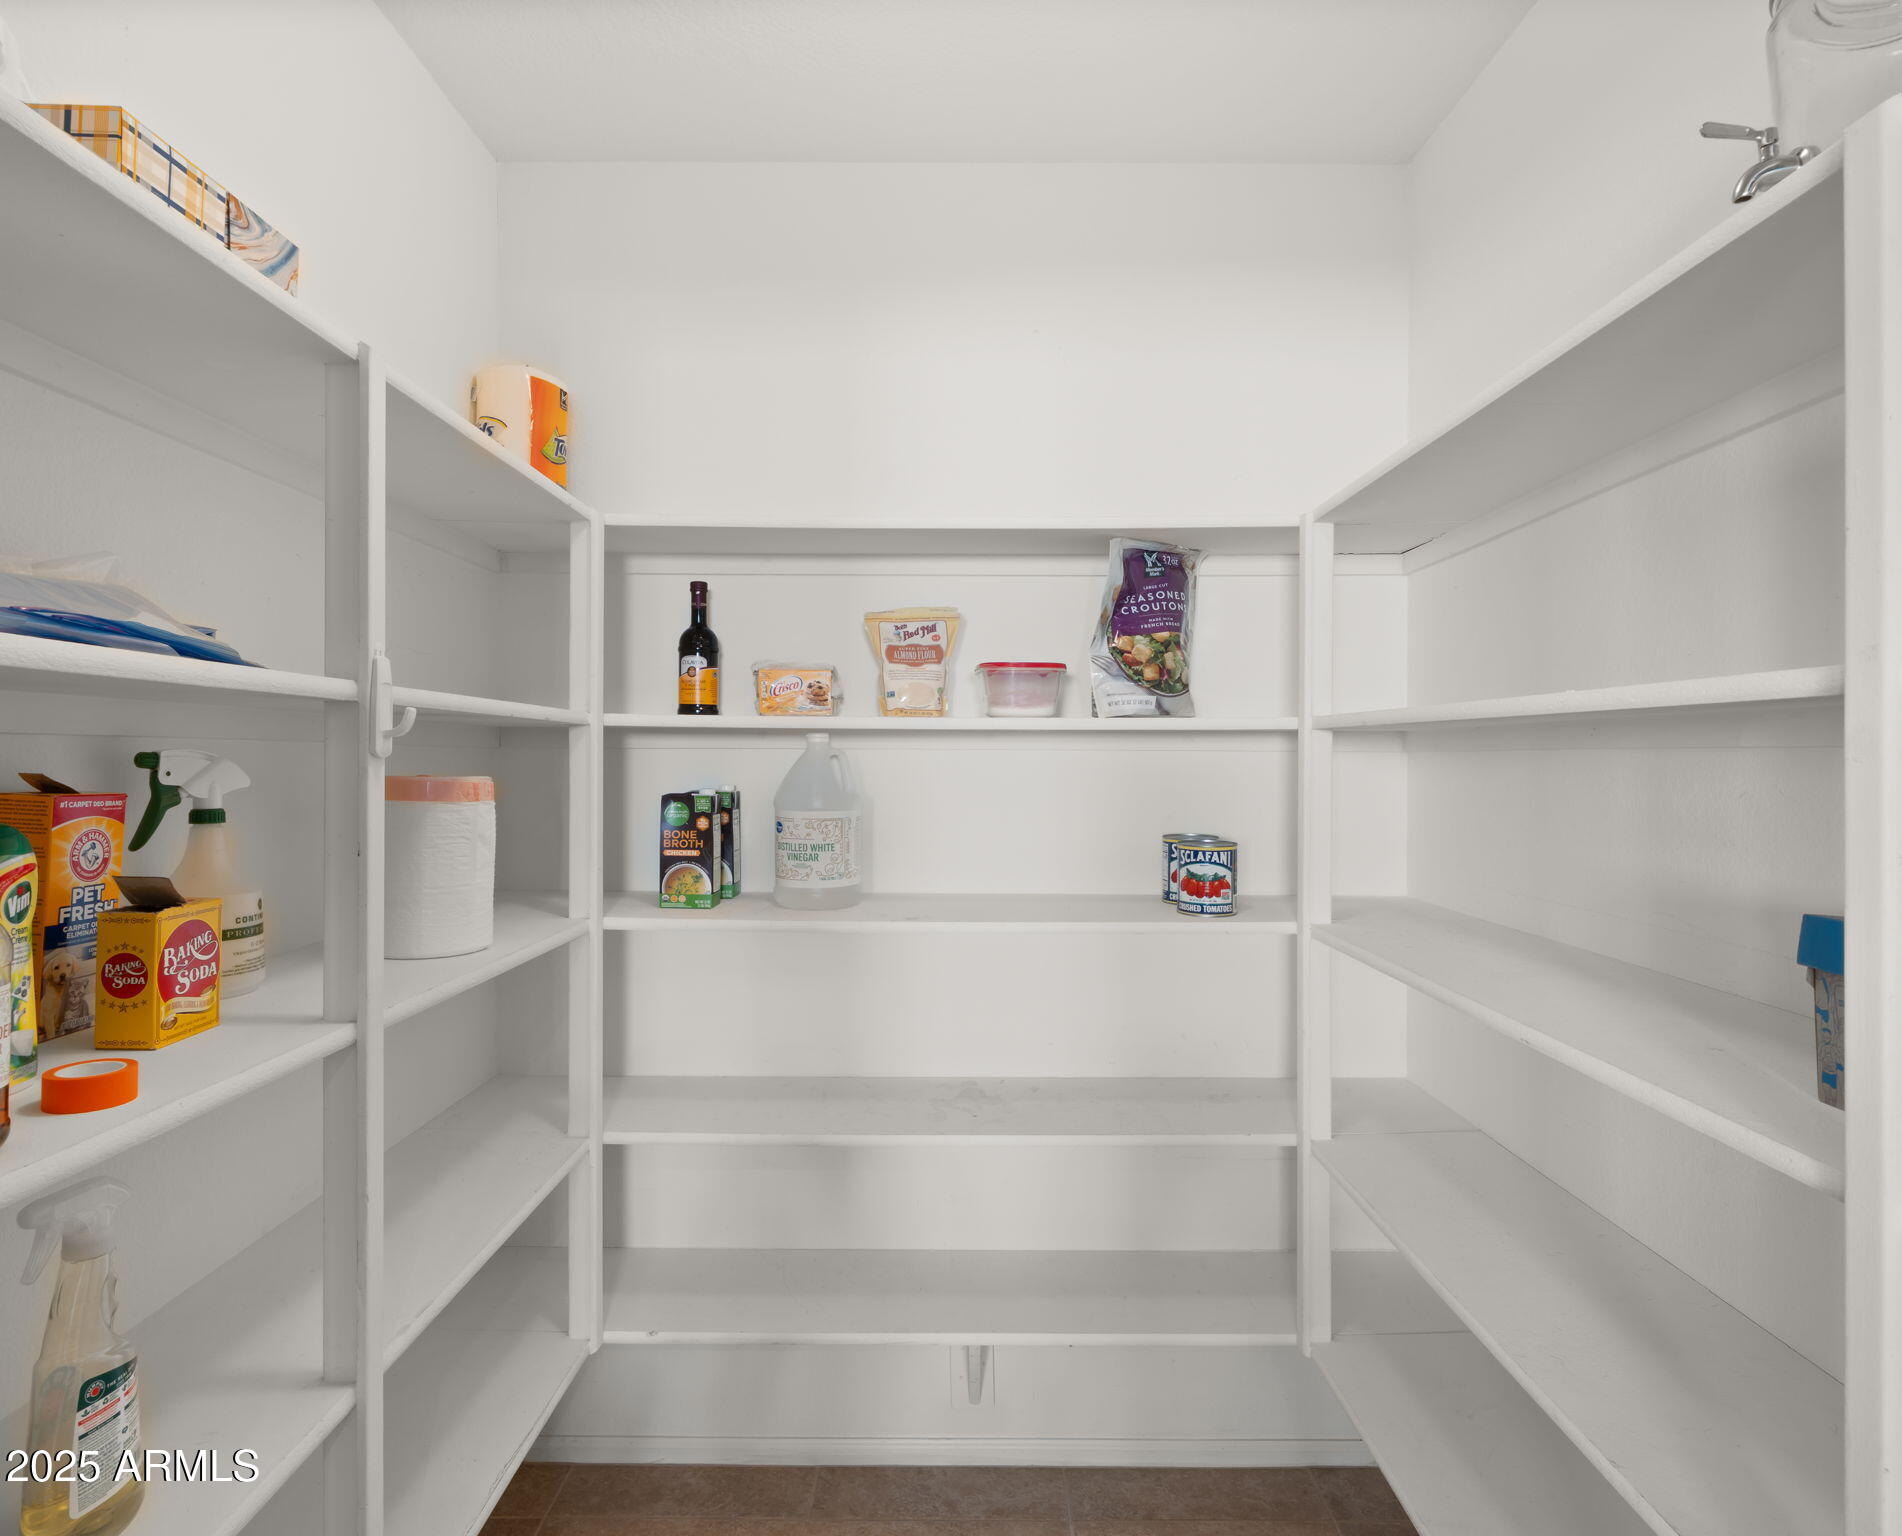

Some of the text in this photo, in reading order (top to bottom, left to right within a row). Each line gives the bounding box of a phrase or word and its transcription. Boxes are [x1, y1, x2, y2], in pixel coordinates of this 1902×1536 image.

[1124, 590, 1186, 603] SEASONED
[903, 626, 919, 641] Red
[920, 622, 937, 639] Mill
[894, 650, 936, 659] ALMOND FLOUR
[773, 680, 800, 697] Crisco
[69, 800, 92, 808] CARPET
[663, 830, 698, 839] BONE
[73, 841, 84, 862] ARM
[88, 831, 110, 859] HAMMER
[663, 839, 704, 848] BROTH
[810, 843, 836, 852] WHITE
[786, 852, 819, 862] VINEGAR
[1180, 850, 1232, 867] SCLAFANI
[72, 884, 105, 904] PET
[8, 887, 31, 918] Vim
[1203, 904, 1233, 913] TOMATOES
[59, 900, 115, 924] FRESH
[11, 926, 29, 936] Cream
[62, 922, 90, 933] CARPET
[163, 930, 218, 976] BAKING
[104, 960, 147, 978] BAKING
[112, 976, 146, 989] SODA
[175, 962, 217, 995] SODA
